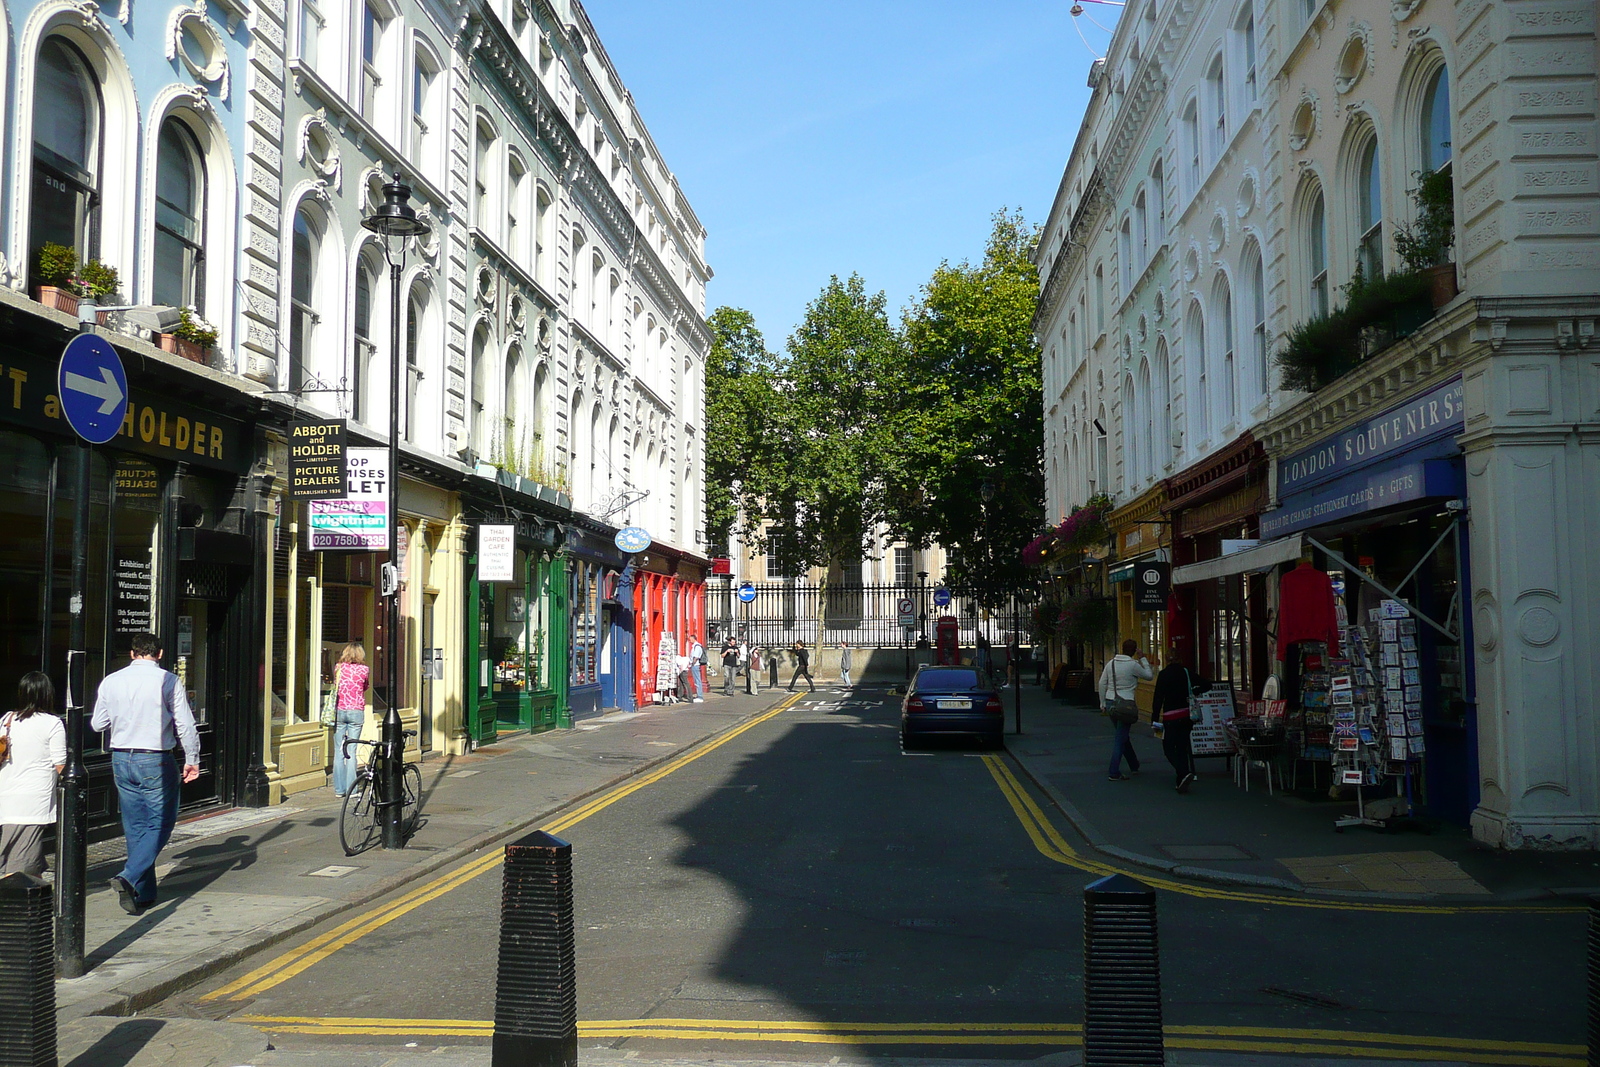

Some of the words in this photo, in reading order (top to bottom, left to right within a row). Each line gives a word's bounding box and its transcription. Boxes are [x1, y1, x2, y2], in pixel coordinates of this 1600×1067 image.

[46, 175, 66, 193] and
[119, 402, 224, 460] HOLDER
[293, 425, 341, 437] ABBOTT
[309, 436, 325, 444] and
[1284, 445, 1337, 485] LONDON
[1346, 393, 1454, 461] SOUVENIRS
[293, 444, 341, 457] HOLDER
[347, 458, 369, 468] OP
[295, 466, 338, 476] PICTURE
[347, 470, 385, 479] MISES
[294, 476, 341, 486] DEALERS
[348, 481, 386, 493] LET
[1291, 506, 1313, 524] CHANGE
[1314, 495, 1350, 517] STATIONERY
[1351, 487, 1375, 506] CARDS
[1379, 485, 1385, 497] &
[1391, 474, 1414, 494] GIFTS
[313, 536, 332, 546] 020
[334, 535, 358, 546] 7580
[361, 535, 385, 546] 9335
[120, 559, 144, 569] Exhibition
[126, 592, 149, 602] Drawings
[1246, 702, 1265, 716] £1.99
